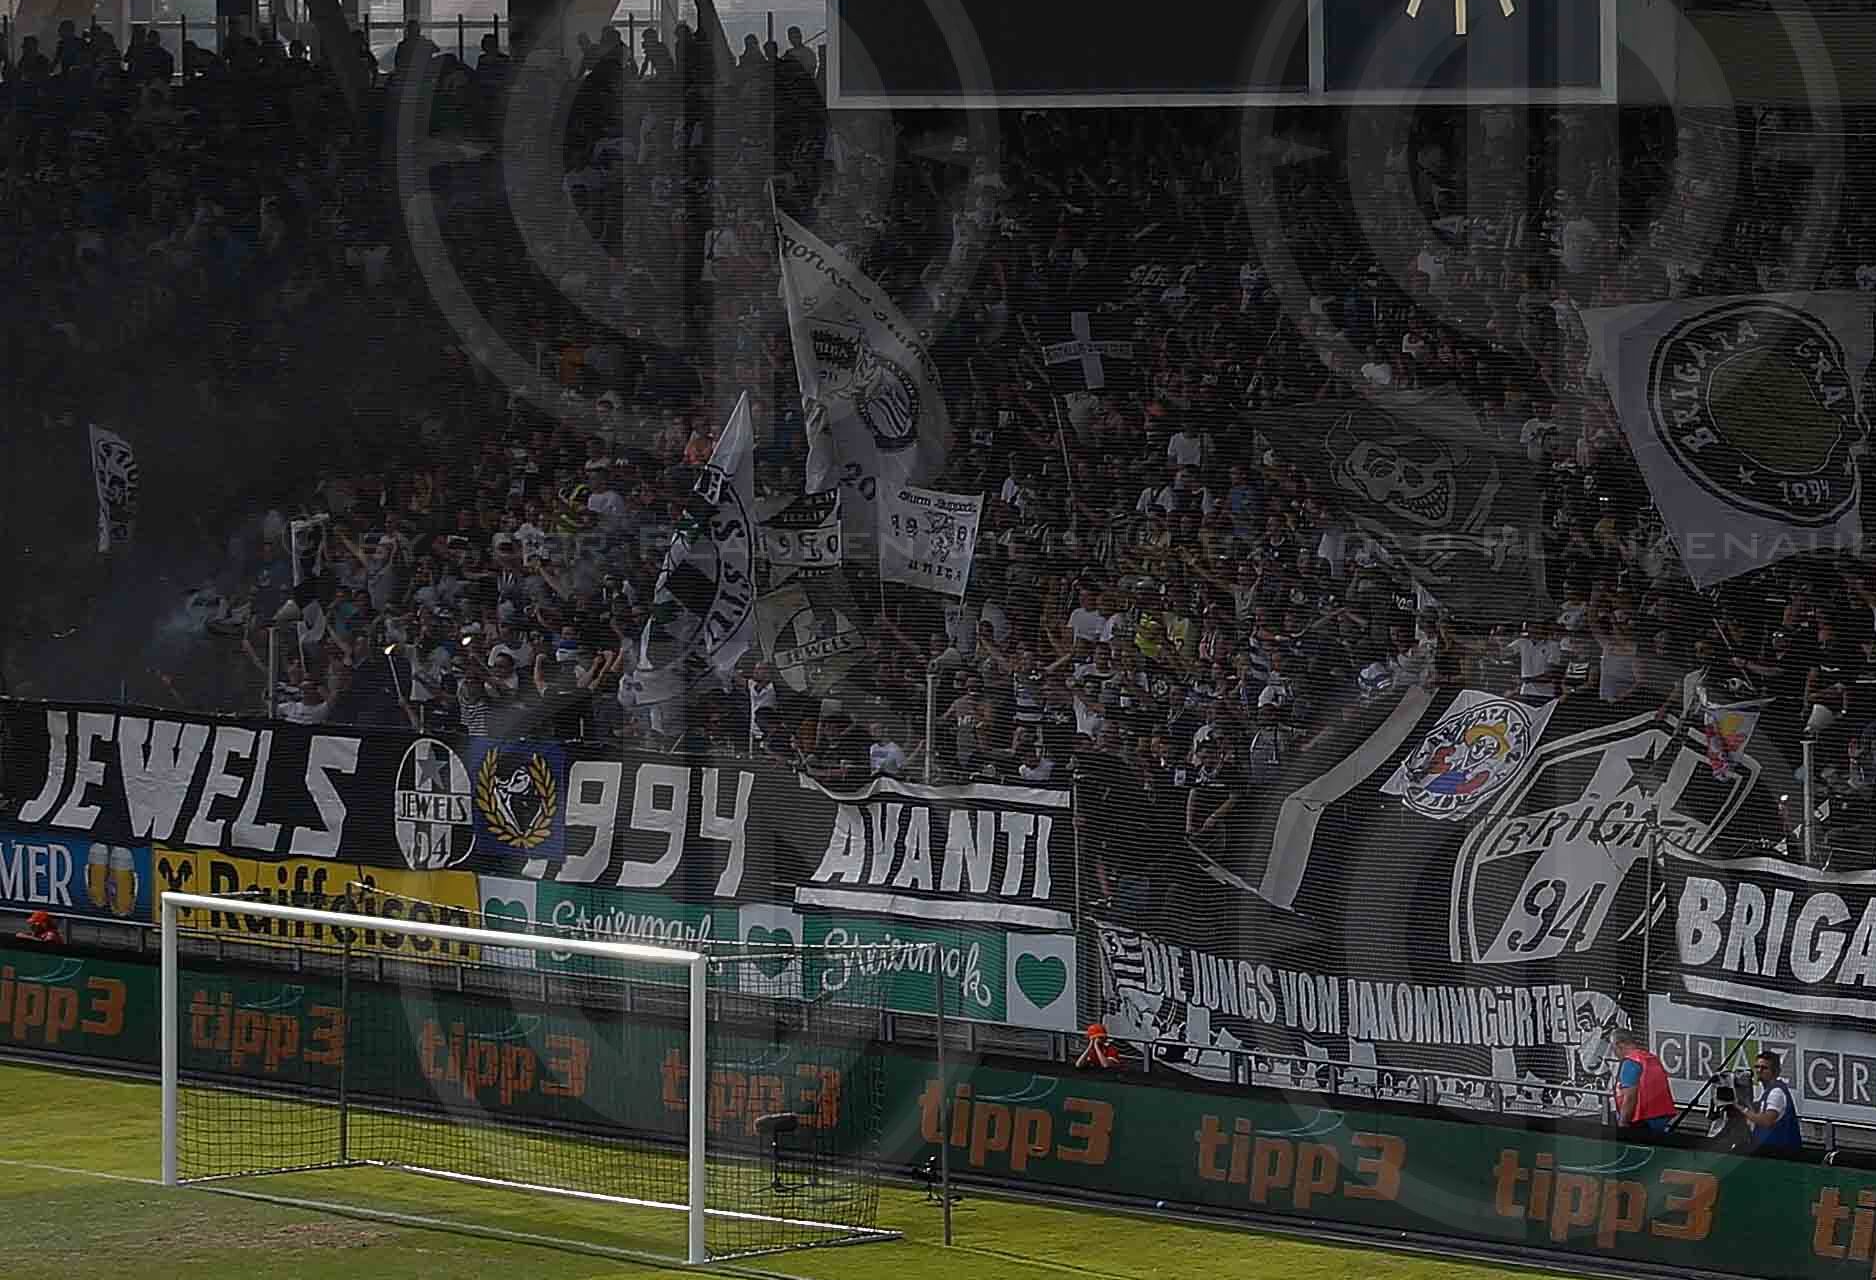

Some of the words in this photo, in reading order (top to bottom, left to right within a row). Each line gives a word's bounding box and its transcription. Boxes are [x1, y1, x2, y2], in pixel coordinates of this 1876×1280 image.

[18, 709, 361, 858] JEWELS
[523, 761, 754, 897] 994
[399, 793, 468, 821] JEWELS
[810, 802, 1053, 900] AVANTI
[1507, 879, 1608, 952] 94
[191, 989, 346, 1072] tipp3
[1141, 936, 1187, 1001] DIE
[1190, 950, 1277, 1024] JUNGS
[1278, 970, 1341, 1034] VOM
[421, 1024, 590, 1104] tipp3
[662, 1047, 843, 1138] tpp3
[919, 1078, 1115, 1170] tipp3
[1194, 1112, 1405, 1209] tipp3
[1494, 1149, 1719, 1248] tipp3
